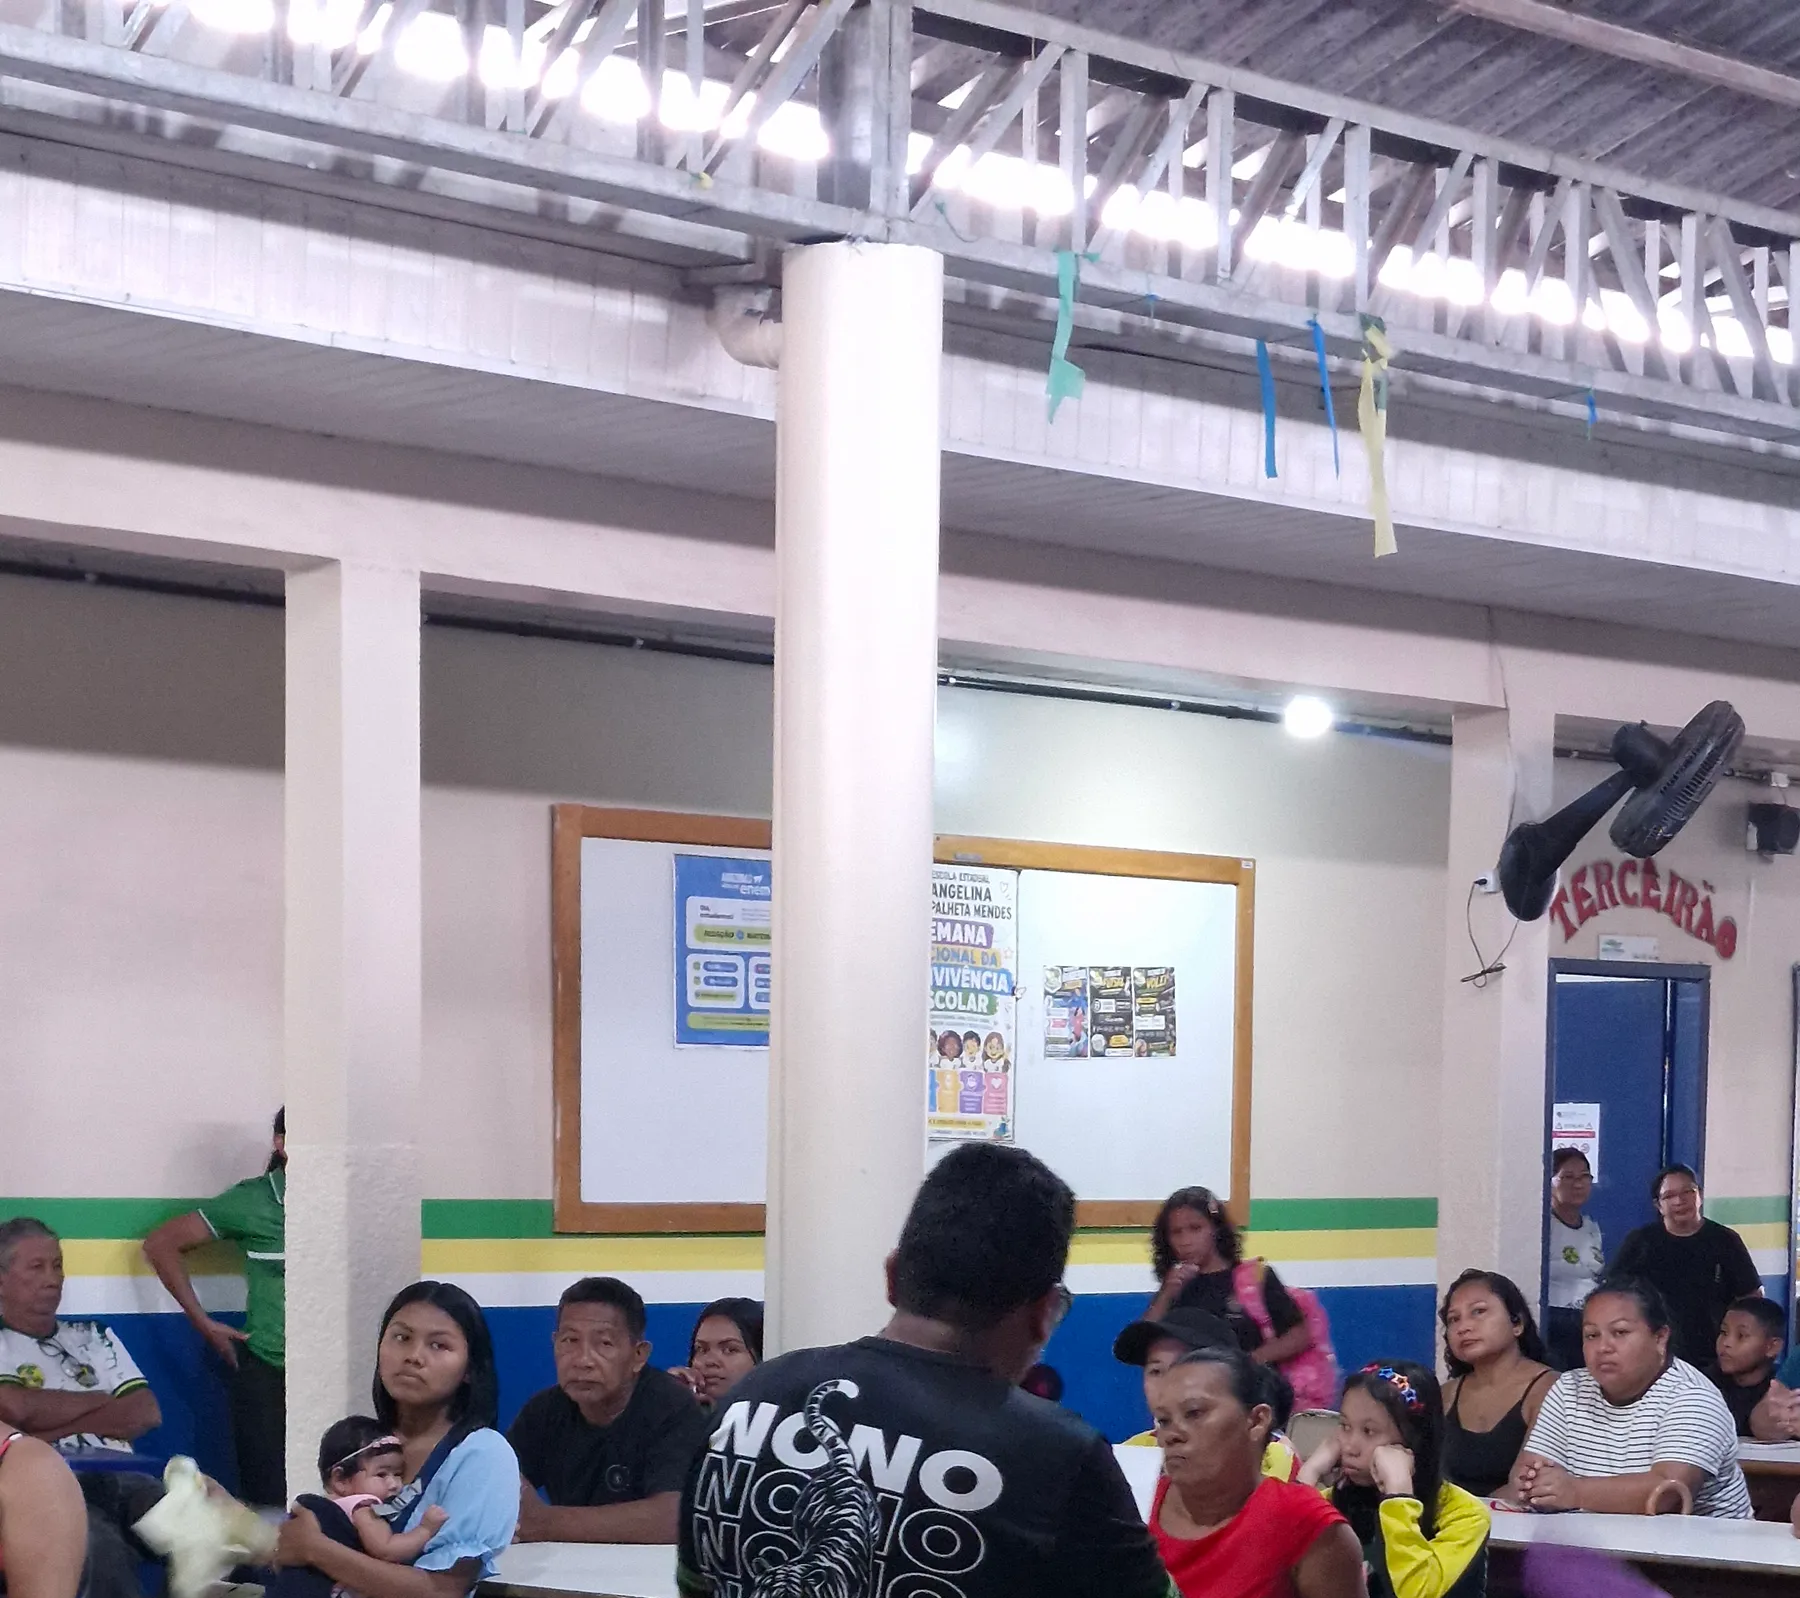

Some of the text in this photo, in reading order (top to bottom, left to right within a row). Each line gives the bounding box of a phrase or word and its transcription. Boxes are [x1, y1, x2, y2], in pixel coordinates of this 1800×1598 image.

[932, 882, 992, 902] ANGELINA
[973, 904, 1012, 920] MENDES
[1549, 857, 1738, 960] TERCEIRÃO
[932, 921, 987, 946] EMANA
[932, 946, 997, 966] IONAL DA
[932, 964, 1009, 994] VIVÊNCIA
[929, 990, 988, 1013] SCOLAR
